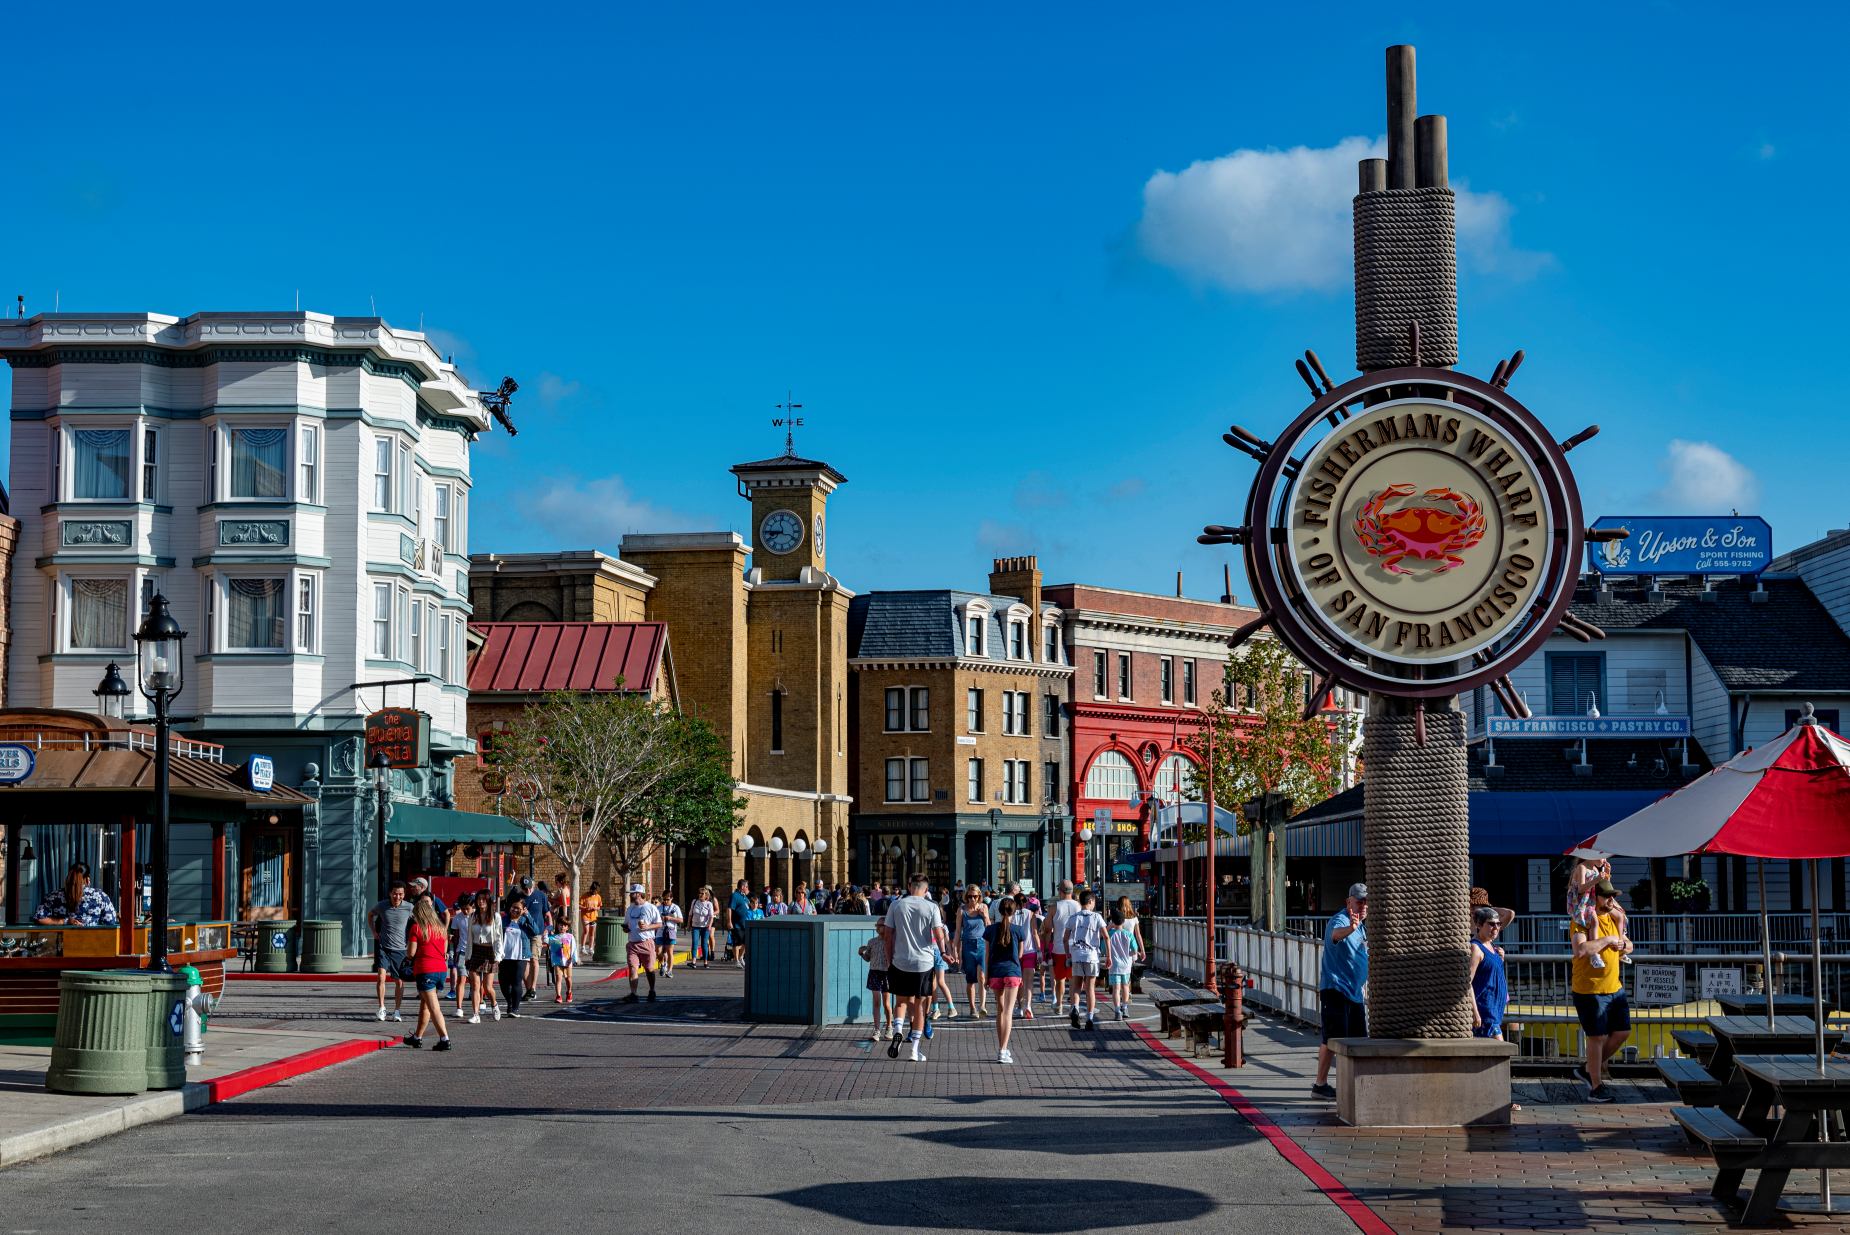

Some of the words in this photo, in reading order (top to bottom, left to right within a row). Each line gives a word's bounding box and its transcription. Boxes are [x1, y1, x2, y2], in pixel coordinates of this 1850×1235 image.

[772, 419, 783, 427] W
[796, 418, 804, 426] E
[1304, 413, 1461, 527] FISHERMANS
[1468, 428, 1538, 527] WHARF
[1638, 530, 1698, 564] Upson
[1701, 528, 1718, 548] &
[1721, 525, 1756, 548] Son
[1696, 558, 1712, 570] Call
[1309, 552, 1342, 587] OF
[1331, 589, 1390, 639] SAN
[1394, 553, 1535, 648] FRANCISCO
[384, 714, 400, 724] the
[1495, 721, 1520, 732] SAN
[1524, 721, 1595, 732] FRANCISCO
[1611, 721, 1661, 732] PASTRY
[1664, 721, 1683, 732] CO.
